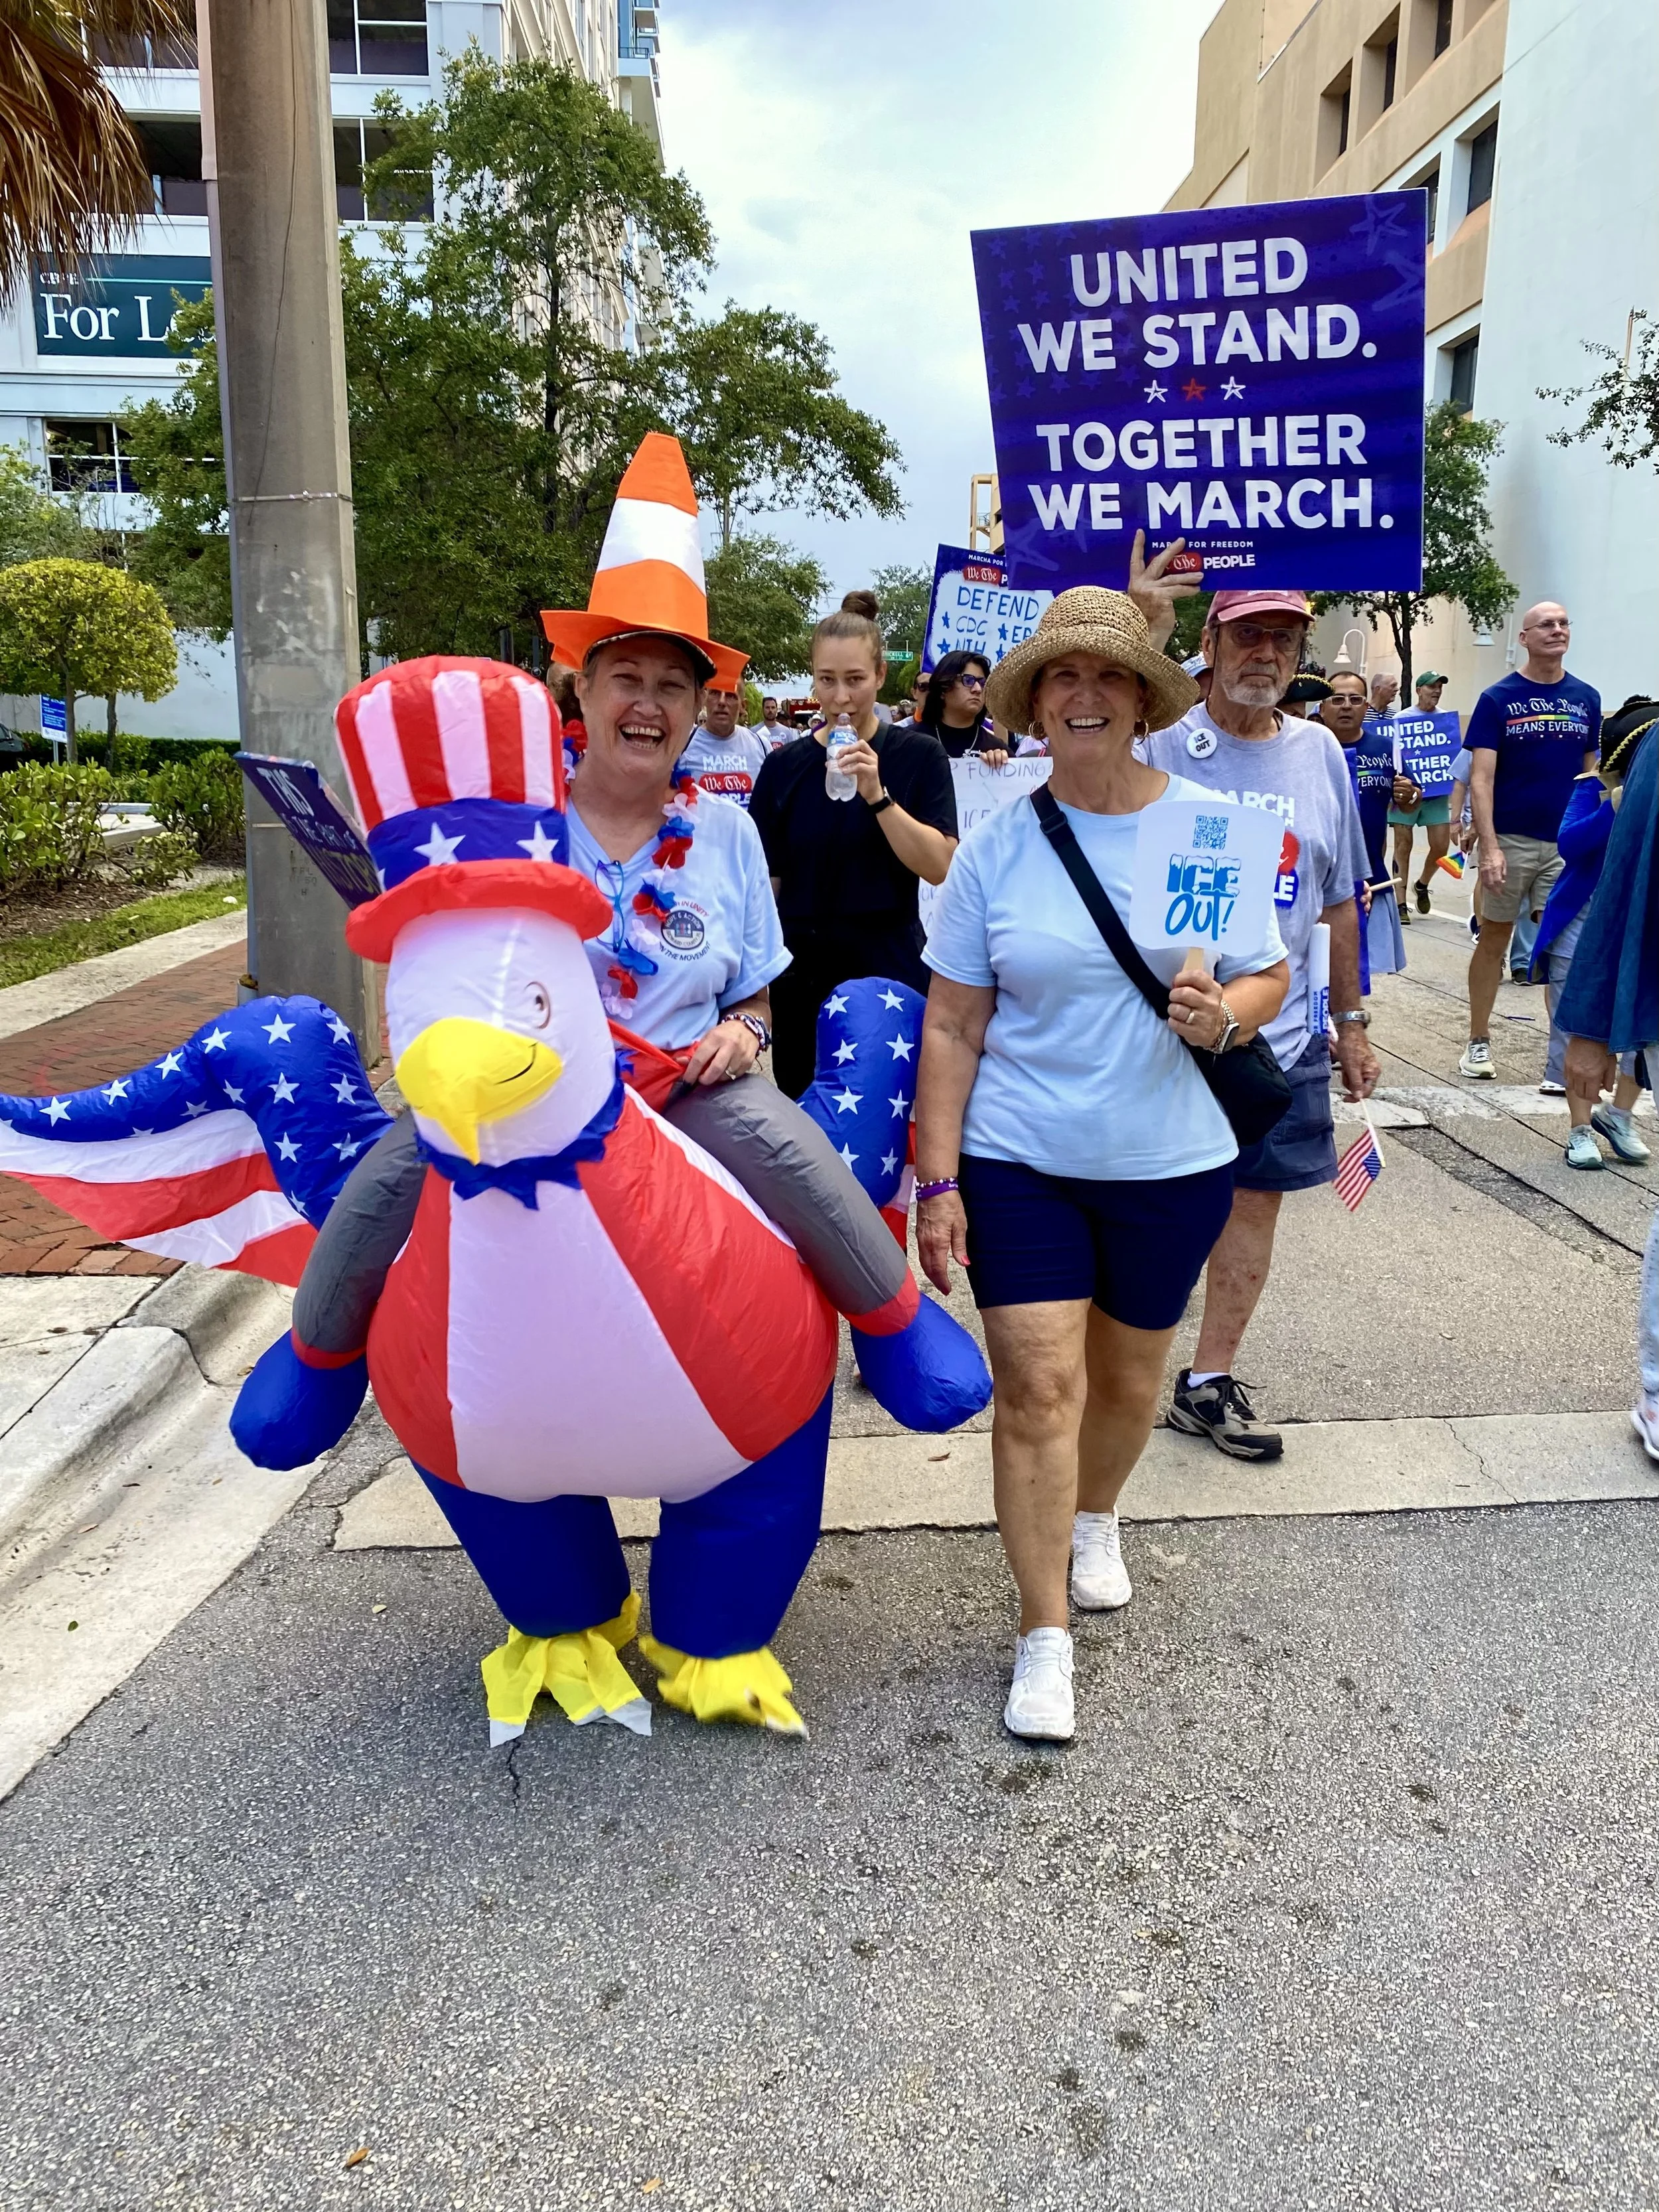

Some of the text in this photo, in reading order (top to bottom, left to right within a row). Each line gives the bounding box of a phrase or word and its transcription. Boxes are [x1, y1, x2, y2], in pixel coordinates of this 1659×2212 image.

[1070, 237, 1308, 307] UNITED
[40, 293, 120, 341] For
[1017, 304, 1377, 373] WE STAND.
[1037, 414, 1367, 472] TOGETHER
[1028, 478, 1394, 530] WE MARCH.
[968, 554, 991, 563] MARCHA
[1203, 554, 1256, 569] PEOPLE
[967, 567, 980, 580] We
[981, 567, 997, 581] The
[957, 585, 1039, 621] DEFEND
[956, 616, 1033, 643] CDC EP
[956, 638, 986, 654] NIH
[1506, 702, 1529, 715] We
[1529, 698, 1555, 712] The
[1506, 721, 1545, 736] MEANS
[1194, 733, 1206, 743] ICE
[1196, 740, 1210, 752] OUT
[703, 755, 748, 767] MARCH
[1356, 753, 1392, 769] People
[1405, 755, 1451, 771] THER
[704, 774, 748, 790] We The
[1214, 789, 1295, 818] ARCH
[1167, 853, 1241, 897] ICE
[1165, 889, 1235, 941] OUT!
[666, 949, 680, 960] THE
